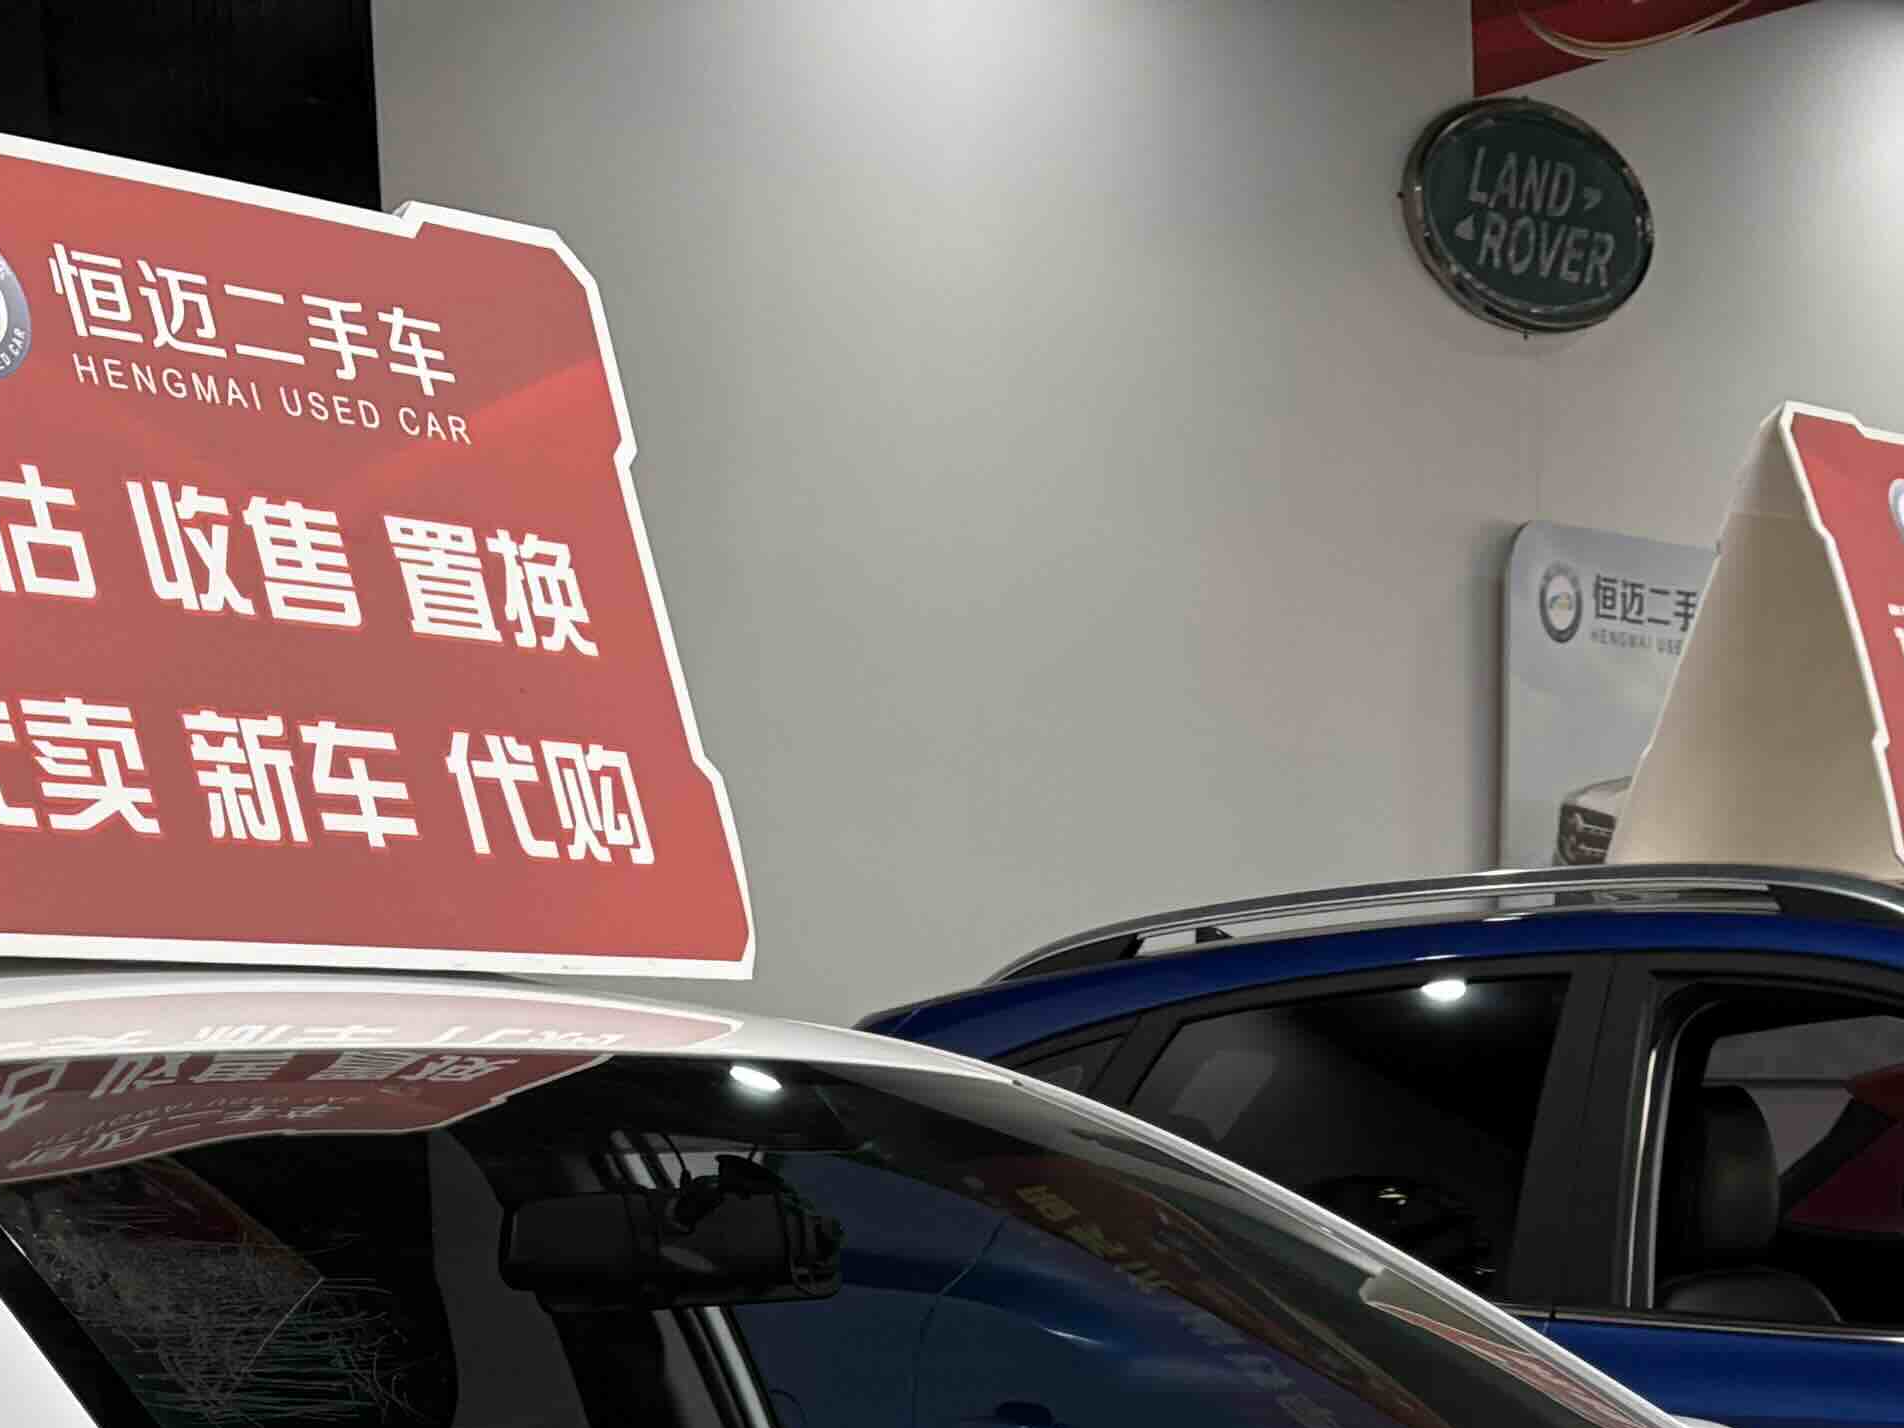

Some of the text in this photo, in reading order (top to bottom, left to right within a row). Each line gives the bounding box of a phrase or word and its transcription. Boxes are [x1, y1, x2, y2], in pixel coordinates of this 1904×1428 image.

[1468, 146, 1576, 217] LAND
[1477, 211, 1615, 288] ROVER
[48, 242, 457, 398] 恒迈二手车
[72, 353, 472, 446] HENGMAI USED CAR
[126, 478, 363, 628] 收售
[383, 512, 600, 657] 置换
[183, 708, 421, 849] 新车
[444, 729, 656, 866] 代购
